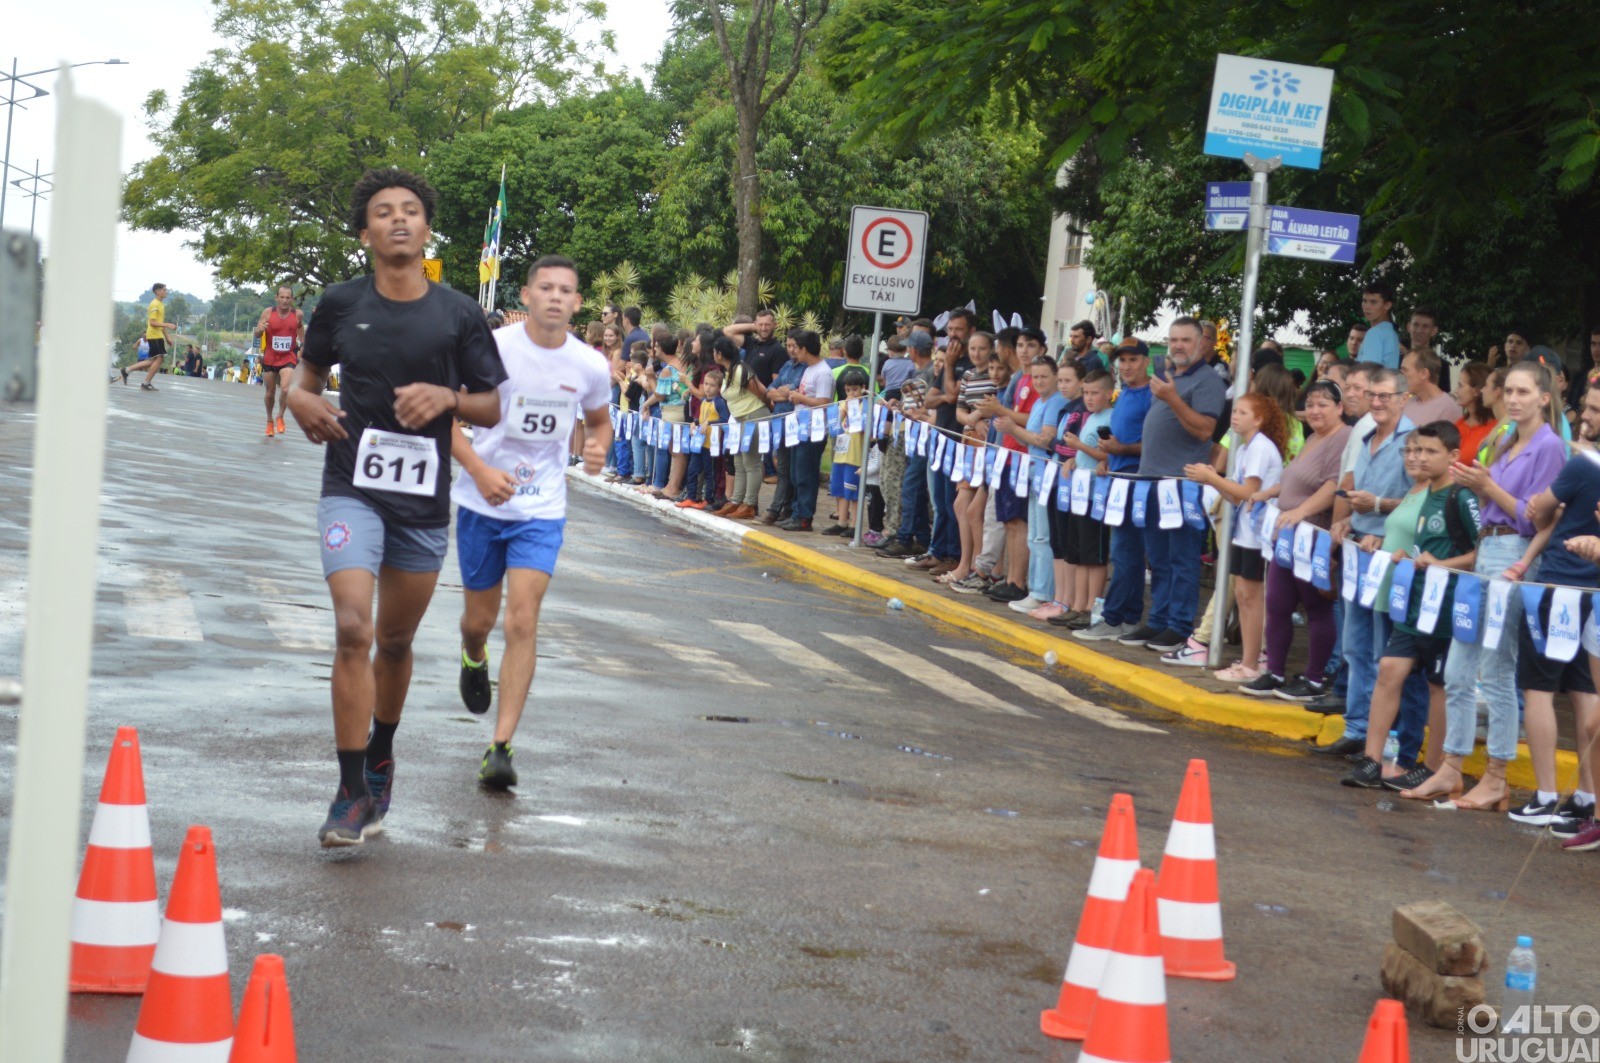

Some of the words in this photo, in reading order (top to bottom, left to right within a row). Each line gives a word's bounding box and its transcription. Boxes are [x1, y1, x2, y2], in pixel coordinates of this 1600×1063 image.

[1219, 92, 1290, 116] DIGIPLAN
[1293, 103, 1323, 120] NET
[1217, 108, 1251, 119] PROVEDOR
[1253, 113, 1273, 122] LEGAL
[1285, 118, 1316, 128] INTERNET
[1211, 186, 1220, 194] RUA
[1272, 209, 1289, 219] RUA
[1271, 220, 1286, 232] DR.
[1288, 219, 1319, 236] ÁLVARO
[1320, 225, 1349, 240] LEITÃO
[878, 228, 897, 257] E
[852, 273, 915, 289] EXCLUSIVO
[870, 288, 896, 302] TÁXI
[273, 341, 290, 349] 518
[521, 412, 557, 435] 59
[363, 452, 427, 485] 611
[1466, 498, 1482, 531] HAVA
[1549, 625, 1578, 641] Banrisul
